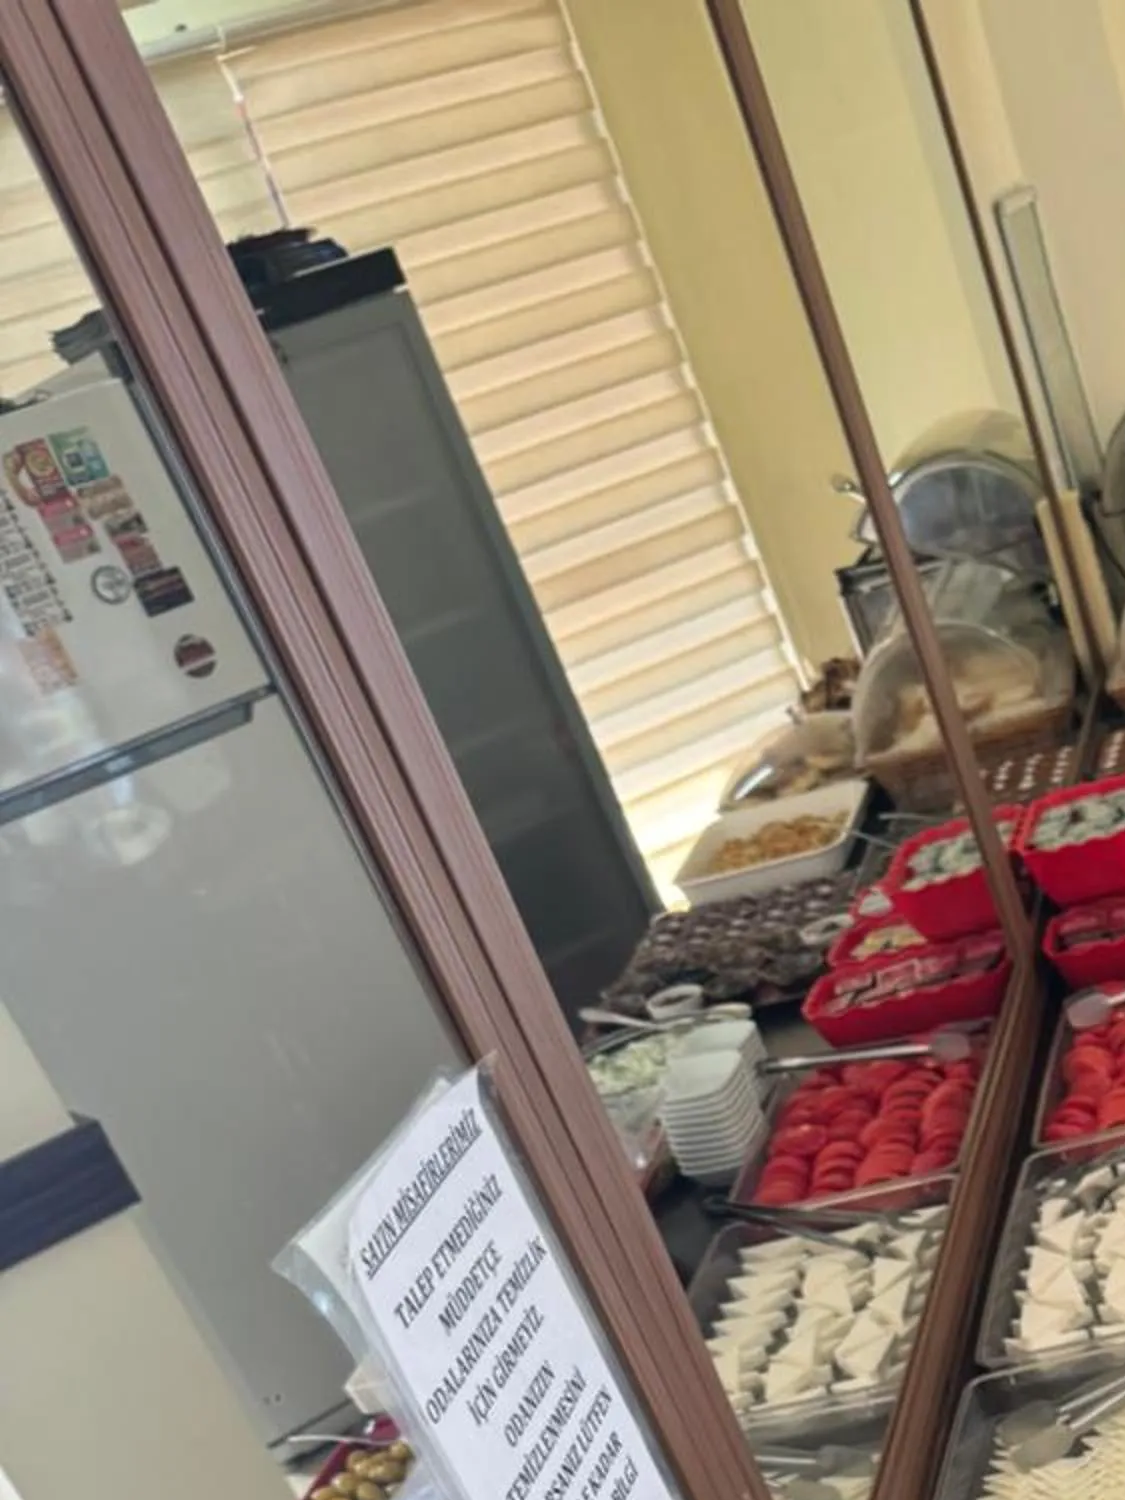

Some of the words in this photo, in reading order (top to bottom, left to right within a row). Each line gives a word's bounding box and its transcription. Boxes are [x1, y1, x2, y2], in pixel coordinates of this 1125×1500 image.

[360, 1213, 399, 1278] SAYIN
[393, 1107, 483, 1232] MİSAFİRLERİMİZ
[393, 1266, 436, 1329] TALEP
[431, 1173, 503, 1280] ETMEDİĞİNİZ
[438, 1239, 503, 1336] MÜDDETÇE
[426, 1305, 503, 1425] ODALARINIZA
[496, 1235, 547, 1313] TEMİZLİK
[466, 1378, 498, 1427] İÇİN
[504, 1360, 556, 1448] ODANIZIN
[576, 1384, 613, 1454] LÜTFEN
[587, 1431, 623, 1496] KADAR
